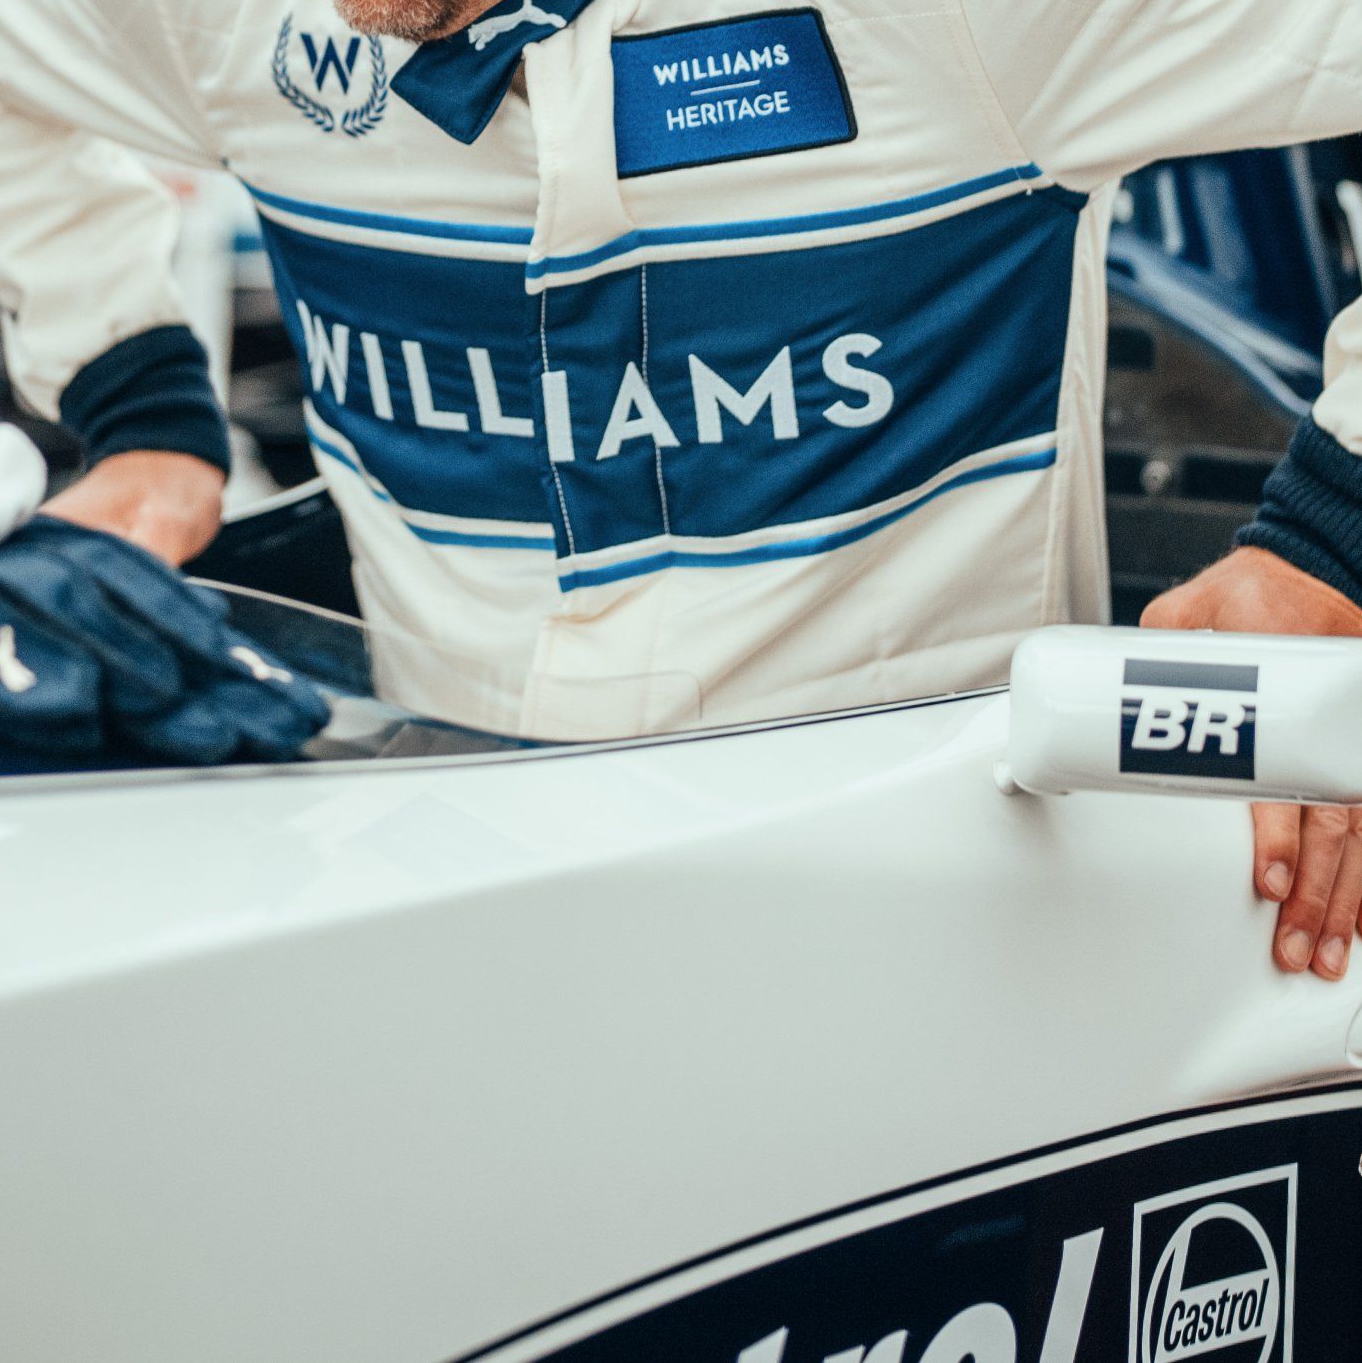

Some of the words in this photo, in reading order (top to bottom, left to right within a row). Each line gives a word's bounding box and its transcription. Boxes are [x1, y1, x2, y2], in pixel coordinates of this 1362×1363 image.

[300, 32, 361, 95] W
[653, 44, 790, 86] WILLIAMS
[666, 91, 791, 131] HERITAGE
[298, 299, 895, 462] WILLIAMS
[1131, 697, 1245, 756] BR
[1163, 1278, 1270, 1353] Castrol
